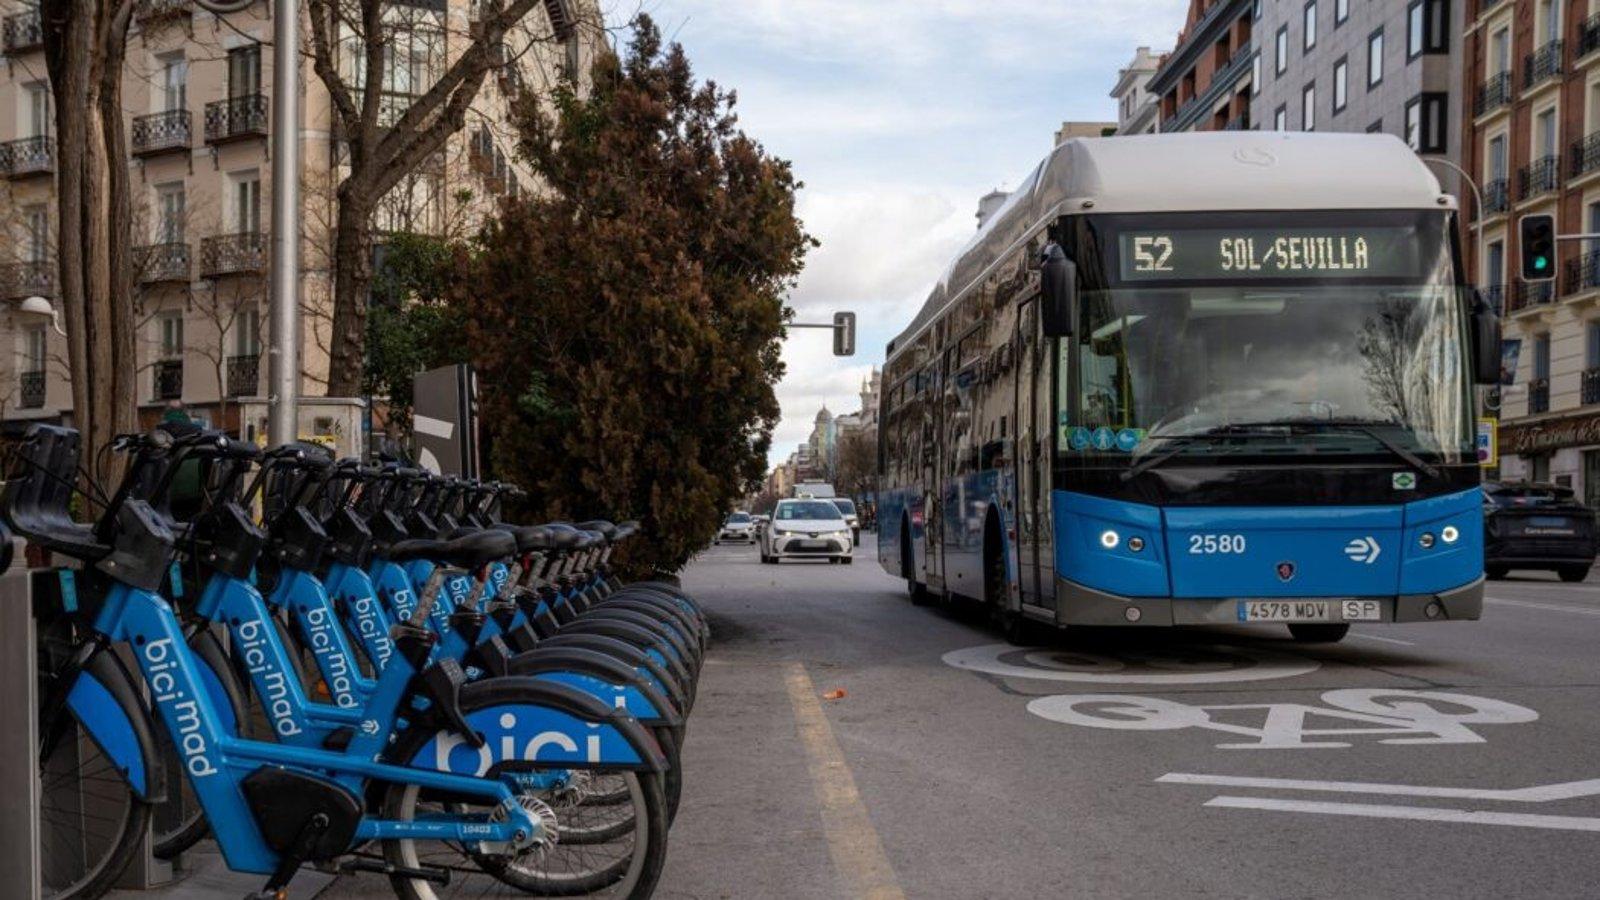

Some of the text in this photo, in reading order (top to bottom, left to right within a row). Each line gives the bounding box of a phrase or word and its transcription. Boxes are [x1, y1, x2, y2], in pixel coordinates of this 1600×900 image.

[1134, 236, 1368, 271] 52 SOL/SEVILLA
[1189, 534, 1246, 554] 2580
[1250, 602, 1290, 619] 4578
[1295, 602, 1327, 618] MDV
